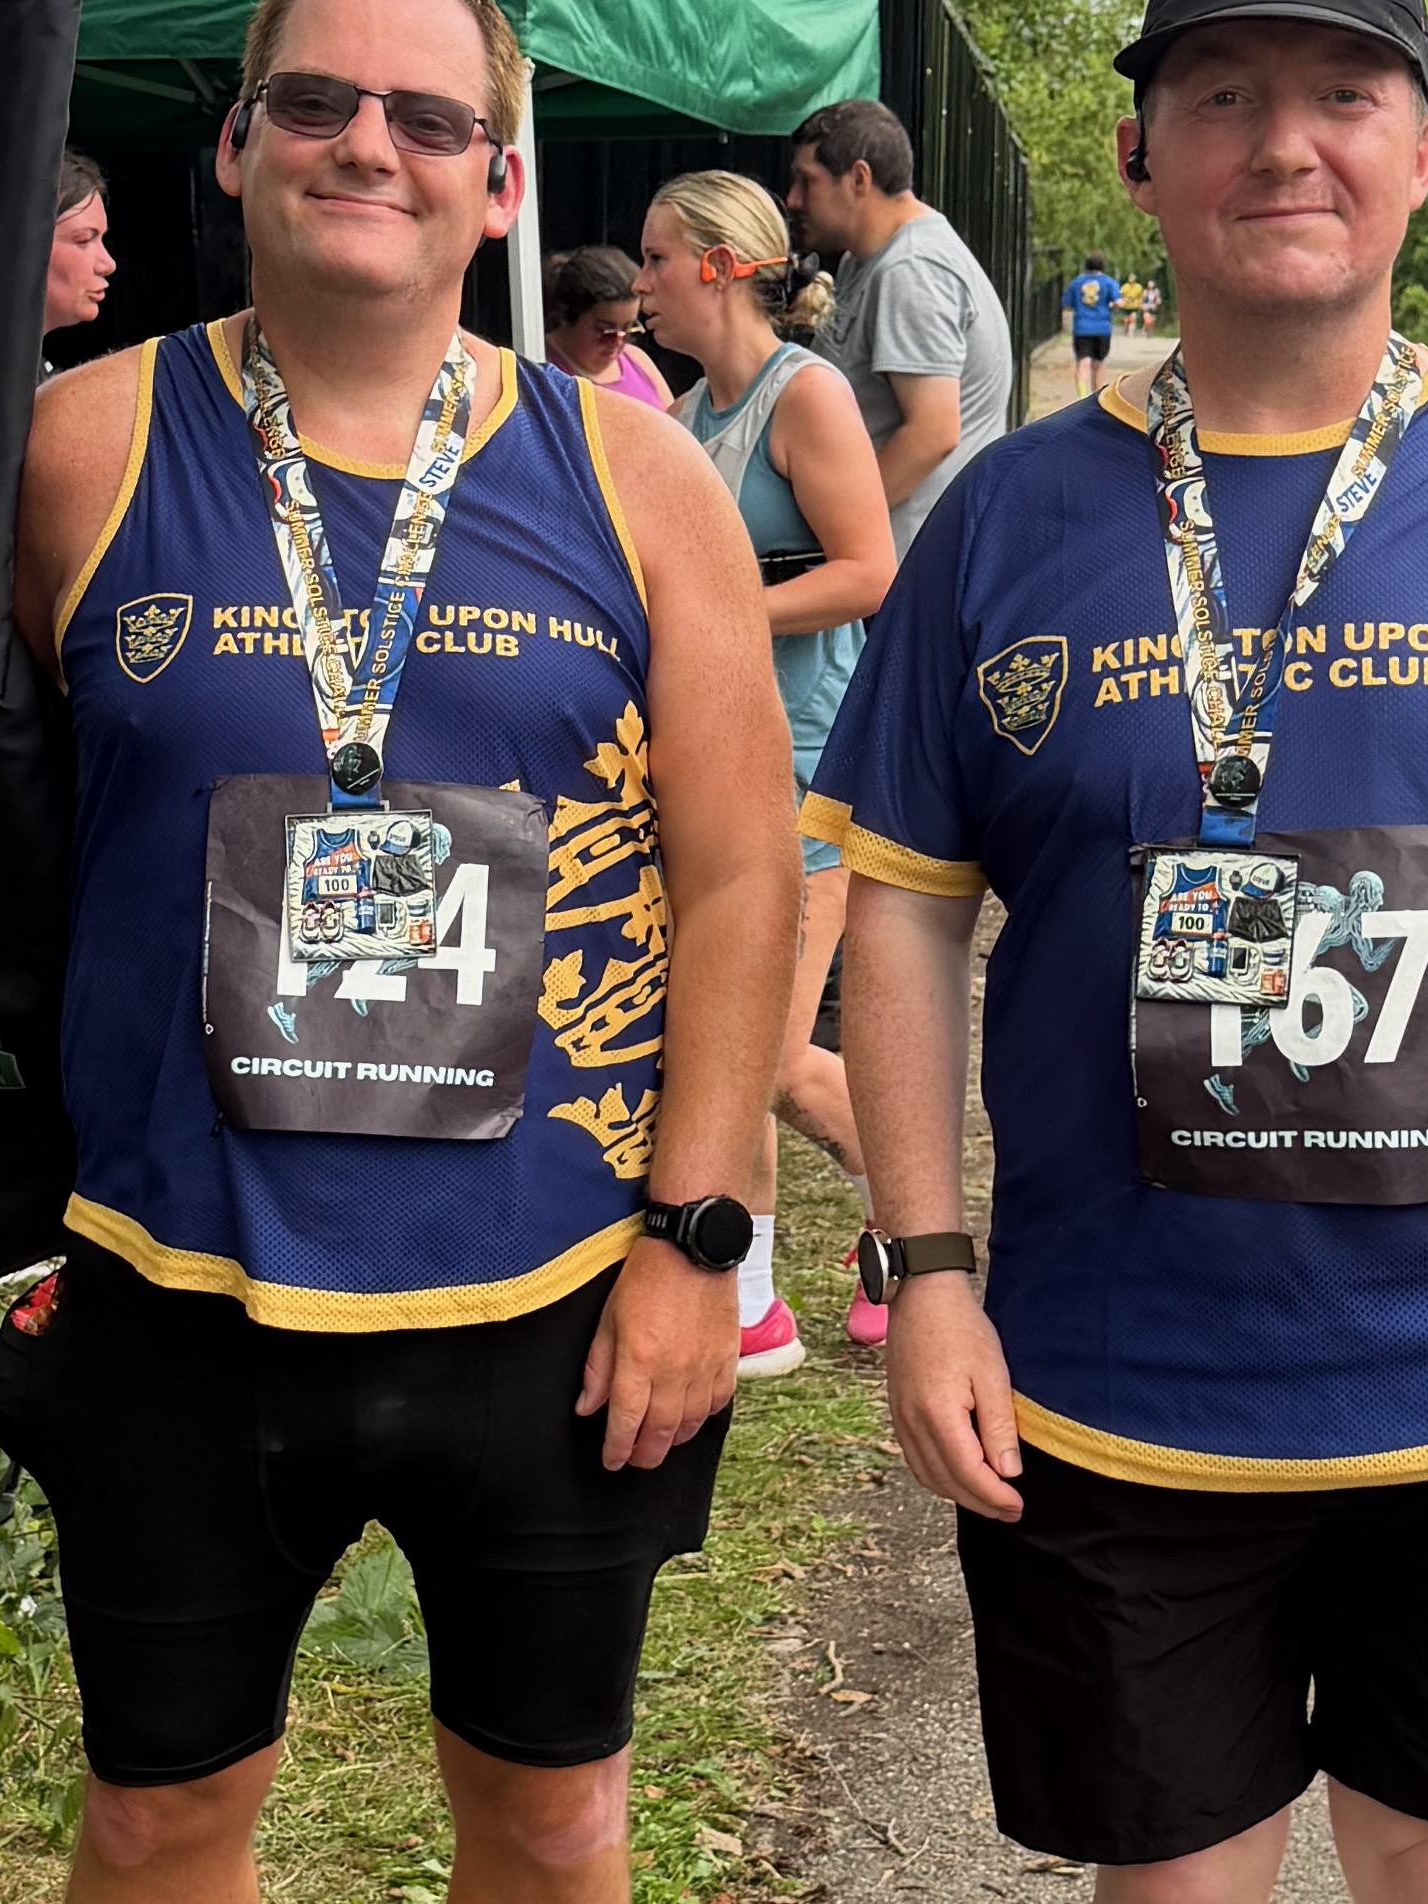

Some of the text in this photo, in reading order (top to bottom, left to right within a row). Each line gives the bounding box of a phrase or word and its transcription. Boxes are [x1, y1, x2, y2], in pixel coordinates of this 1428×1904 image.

[418, 445, 461, 488] STEVE
[1335, 472, 1378, 513] STEVE
[284, 499, 316, 570] SUMMER
[304, 572, 339, 654] SOLSTICE
[1178, 518, 1205, 593] SUMMER
[371, 591, 406, 674] SOLSTICE
[415, 630, 521, 658] CLUB
[428, 604, 537, 636] UPON
[548, 617, 622, 661] HULL
[1191, 596, 1219, 682] SOLSTICE
[324, 878, 350, 892] 100
[1178, 915, 1205, 931] 100
[230, 1055, 496, 1088] CIRCUIT RUNNING
[1170, 1129, 1299, 1149] CIRCUIT
